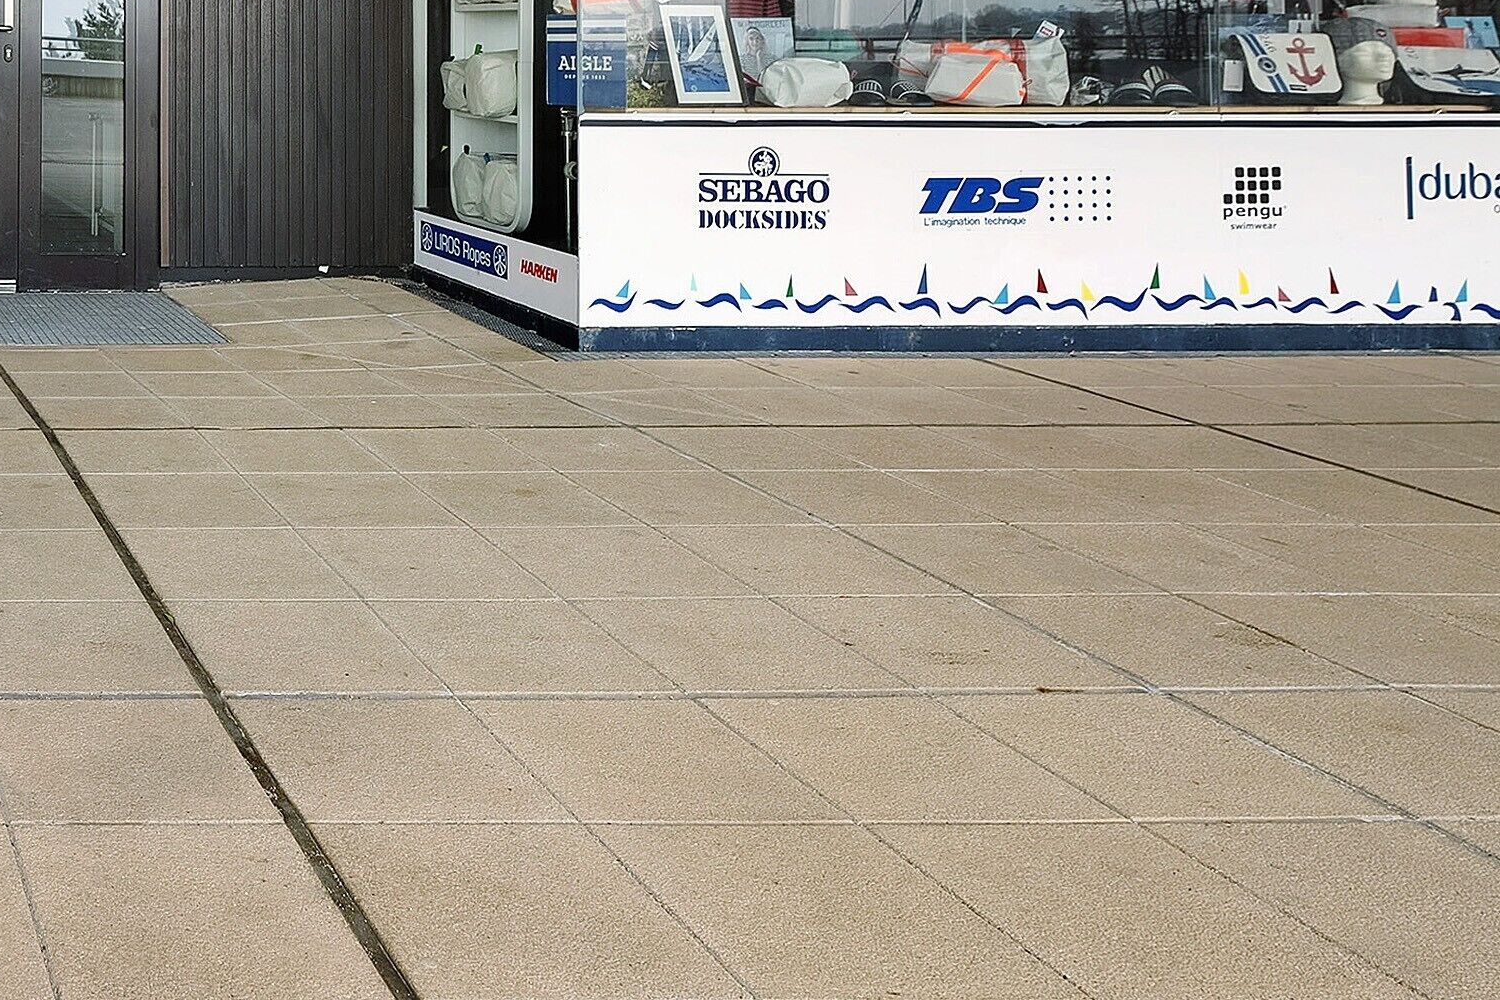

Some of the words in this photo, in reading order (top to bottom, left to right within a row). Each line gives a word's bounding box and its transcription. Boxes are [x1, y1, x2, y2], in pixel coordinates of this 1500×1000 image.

[557, 54, 613, 72] AIGLE
[698, 179, 830, 203] SEBAGO
[1418, 161, 1500, 200] dub
[919, 177, 1045, 214] TBS
[698, 210, 827, 230] DOCKSIDES
[924, 217, 981, 228] L'imagination
[984, 216, 1027, 227] technique
[1223, 206, 1283, 220] pengu
[1230, 222, 1278, 230] swimwear
[434, 231, 461, 257] LIROS
[462, 240, 492, 268] Ropes
[520, 258, 558, 283] HARKEN
